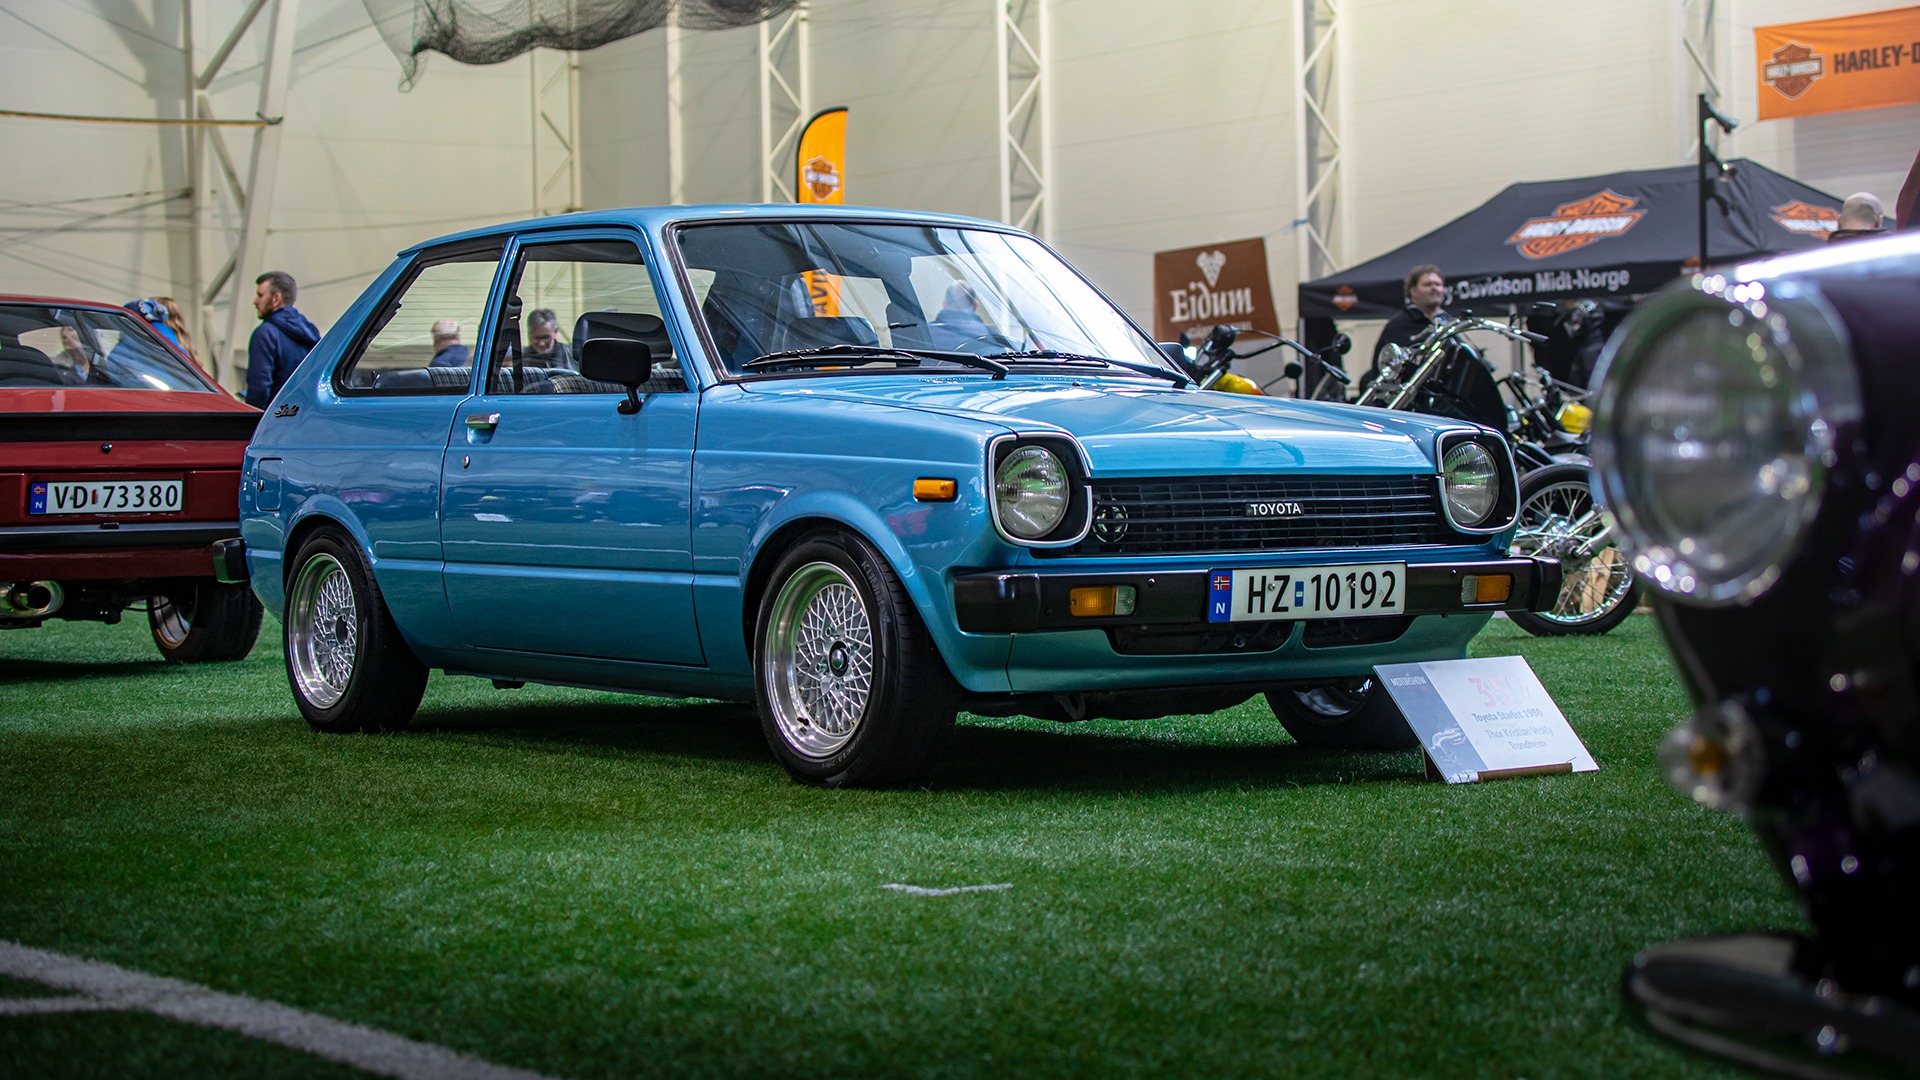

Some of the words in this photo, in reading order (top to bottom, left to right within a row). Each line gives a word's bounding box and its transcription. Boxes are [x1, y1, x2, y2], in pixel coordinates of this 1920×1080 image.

[1444, 276, 1533, 305] y-Davidson
[1535, 268, 1630, 292] Midt-Norge
[1169, 281, 1256, 323] Eidum
[54, 485, 89, 509] VD
[102, 484, 179, 509] 73380
[35, 501, 43, 509] N
[1250, 502, 1302, 516] TOYOTA
[1247, 574, 1291, 614] HZ
[1310, 570, 1396, 612] 10192
[1215, 602, 1226, 614] N
[1471, 712, 1498, 724] Toyota
[1497, 710, 1523, 721] Starlet
[1522, 708, 1544, 719] 1980
[1484, 729, 1503, 739] Thor
[1503, 728, 1532, 738] Kristian
[1508, 740, 1548, 751] Trondheim
